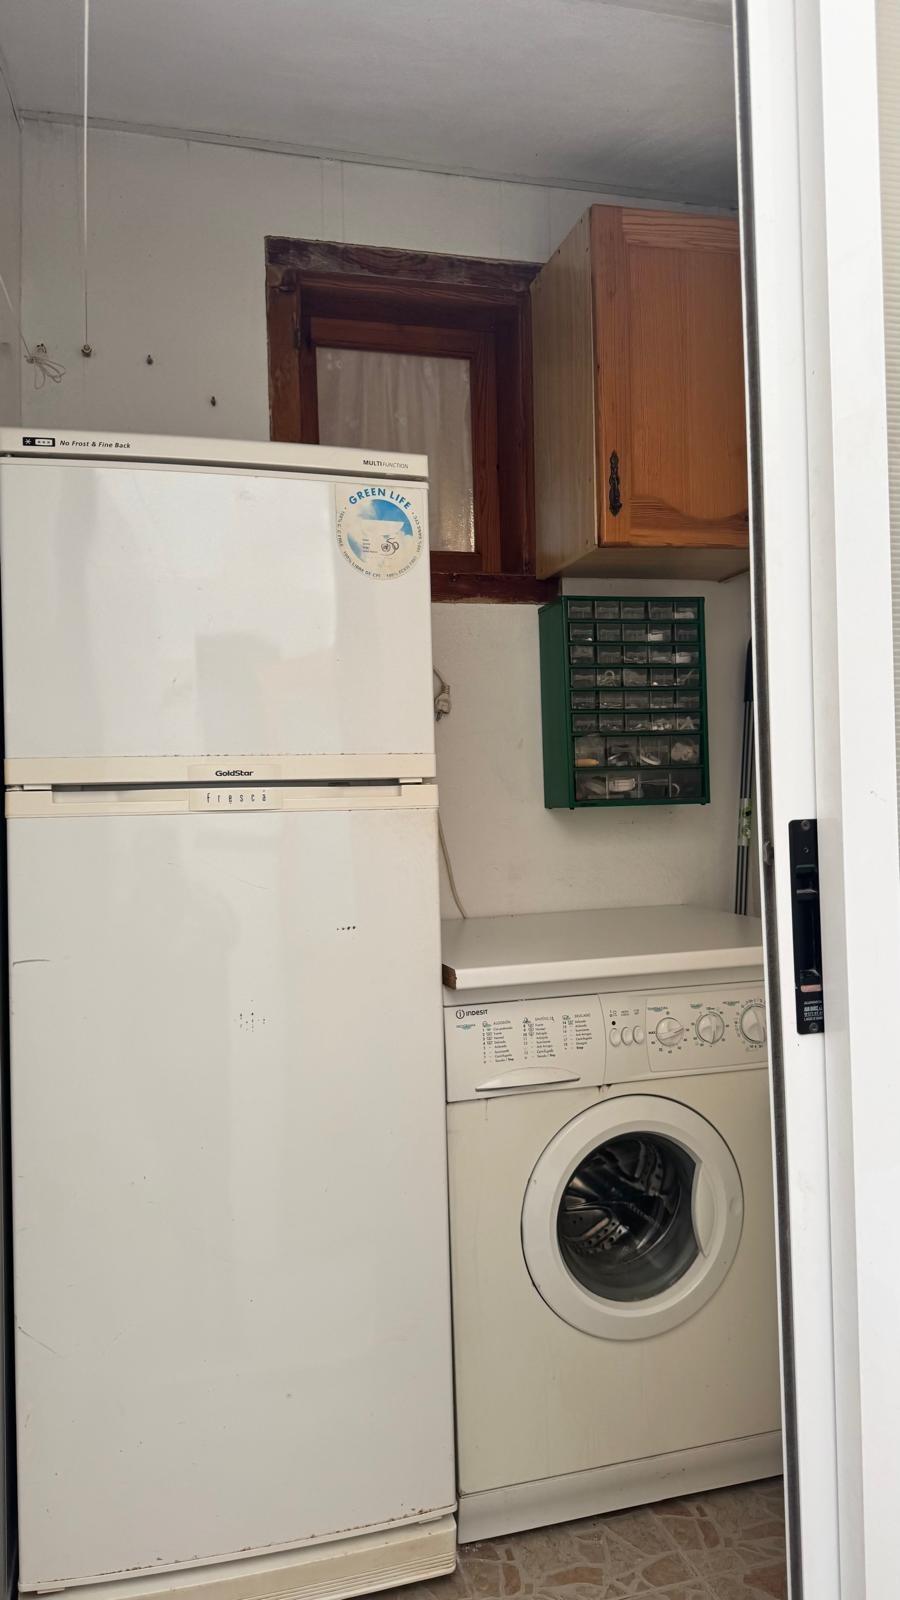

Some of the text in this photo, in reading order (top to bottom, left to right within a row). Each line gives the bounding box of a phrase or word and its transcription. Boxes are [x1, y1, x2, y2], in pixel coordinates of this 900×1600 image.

[348, 487, 412, 510] GREEN LIFE
[215, 769, 255, 777] GoldStar
